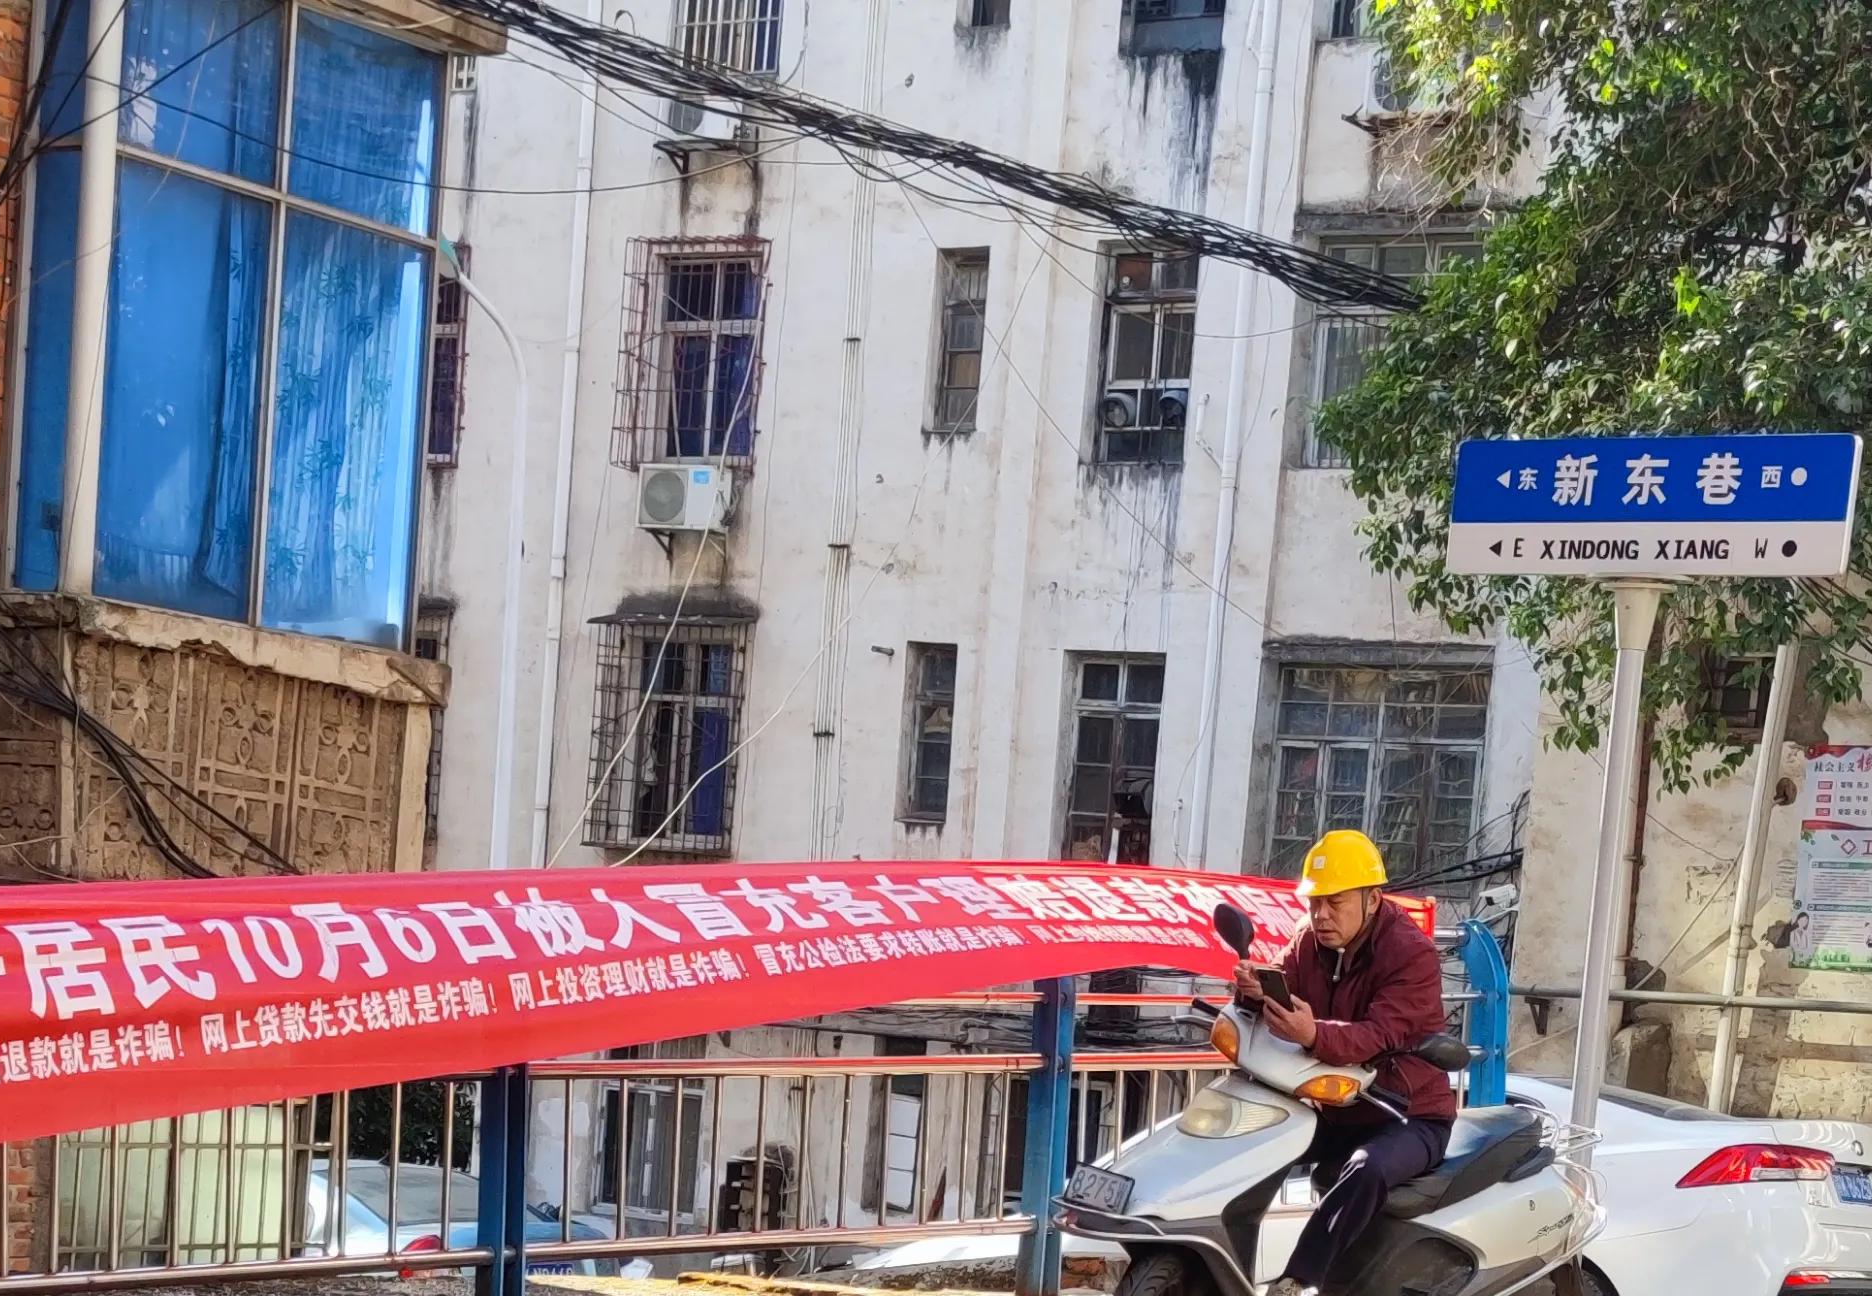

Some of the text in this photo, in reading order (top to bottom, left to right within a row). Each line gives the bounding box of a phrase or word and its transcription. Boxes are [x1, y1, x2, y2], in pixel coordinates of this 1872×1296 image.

[1516, 453, 1783, 506] 东 新东巷 西
[1512, 538, 1769, 560] E XINDONG XIANG W
